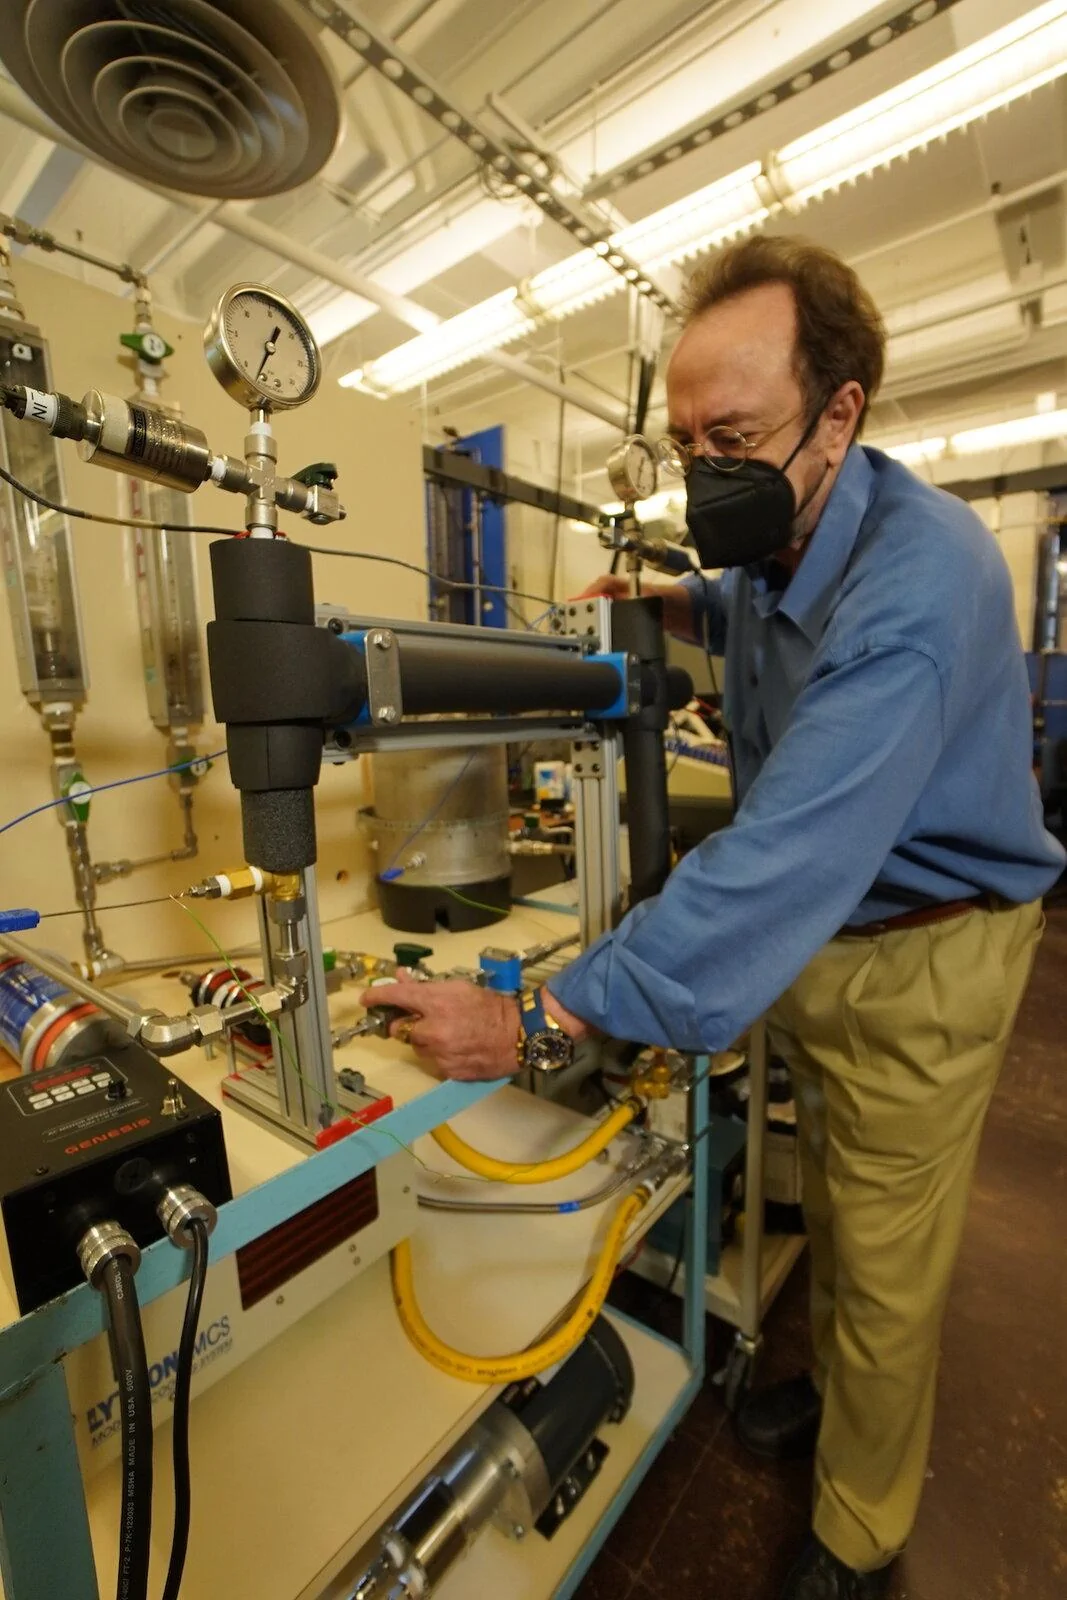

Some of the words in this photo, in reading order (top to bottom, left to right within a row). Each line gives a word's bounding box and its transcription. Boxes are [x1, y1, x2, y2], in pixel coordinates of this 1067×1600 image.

[64, 1117, 151, 1155] GENESIS
[114, 1271, 124, 1300] CAROL
[125, 1369, 135, 1392] 600V
[127, 1397, 136, 1417] USA
[128, 1422, 136, 1434] IN
[128, 1439, 136, 1466] MADE
